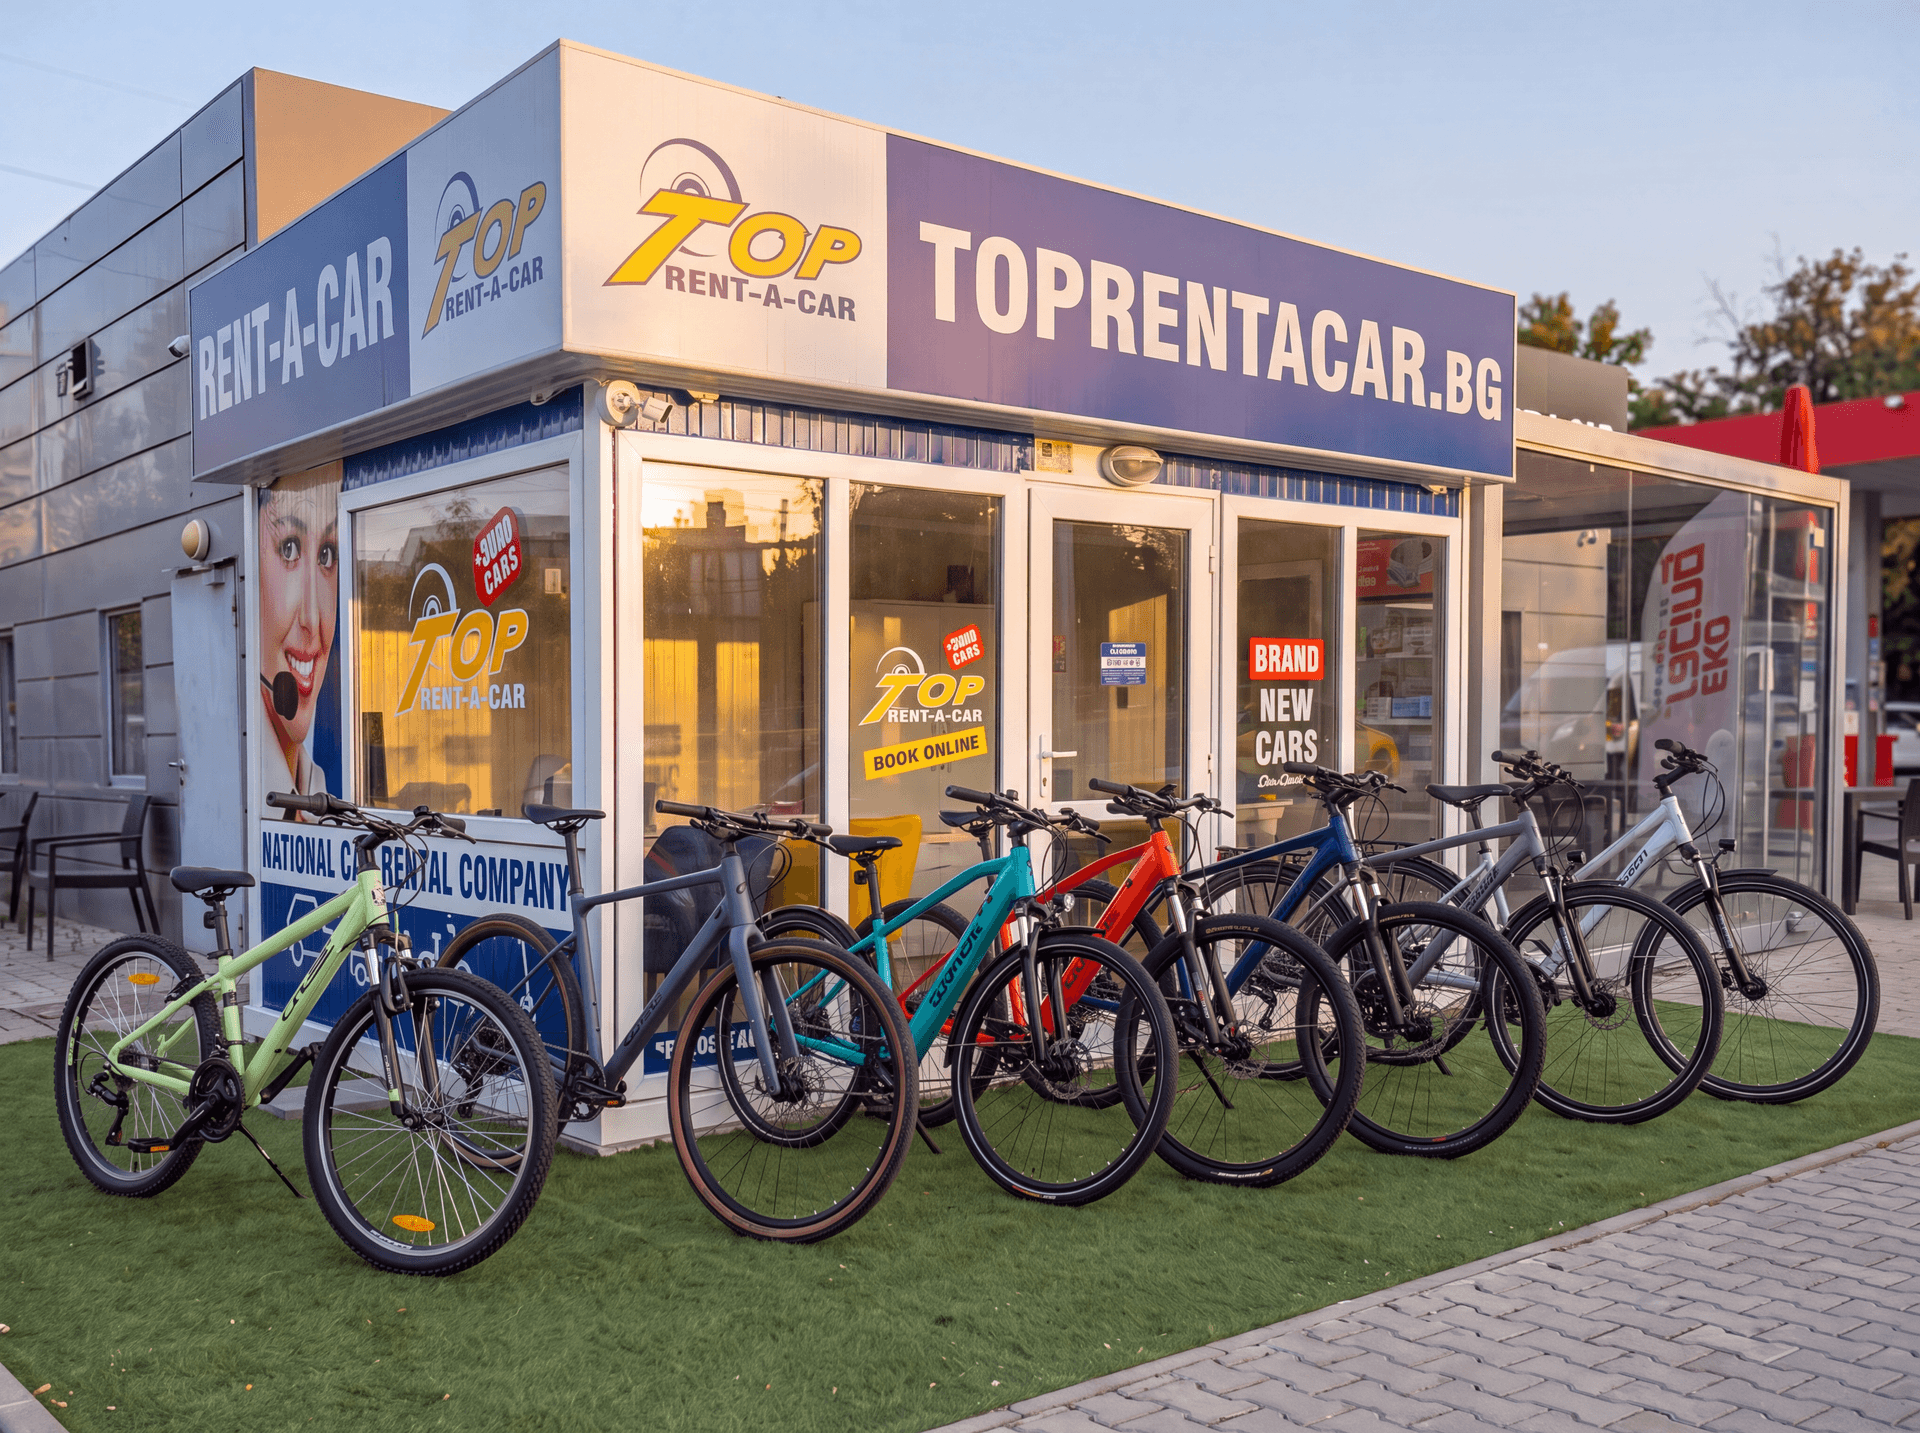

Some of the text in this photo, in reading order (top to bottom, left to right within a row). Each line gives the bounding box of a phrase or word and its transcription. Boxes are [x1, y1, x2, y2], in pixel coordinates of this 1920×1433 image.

[421, 180, 547, 341] TOP
[602, 187, 863, 288] TOP
[445, 255, 544, 322] RENT-A-CAR
[664, 264, 857, 322] RENT-A-CAR
[198, 235, 395, 421] RENT-A-CAR
[919, 220, 1503, 422] TOPRENTACAR.BG
[484, 545, 518, 595] CARS
[394, 608, 529, 718] TOP
[953, 643, 980, 665] CARS
[1255, 644, 1319, 673] BRAND
[420, 683, 525, 711] RENT-A-CAR
[858, 673, 985, 726] TOP
[888, 709, 982, 723] RENT-A-CAR
[1260, 688, 1314, 722] NEW
[873, 735, 980, 771] BOOK ONLINE
[1255, 729, 1318, 766] CARS
[262, 831, 570, 912] NATIONAL CA RENTAL COMPANY
